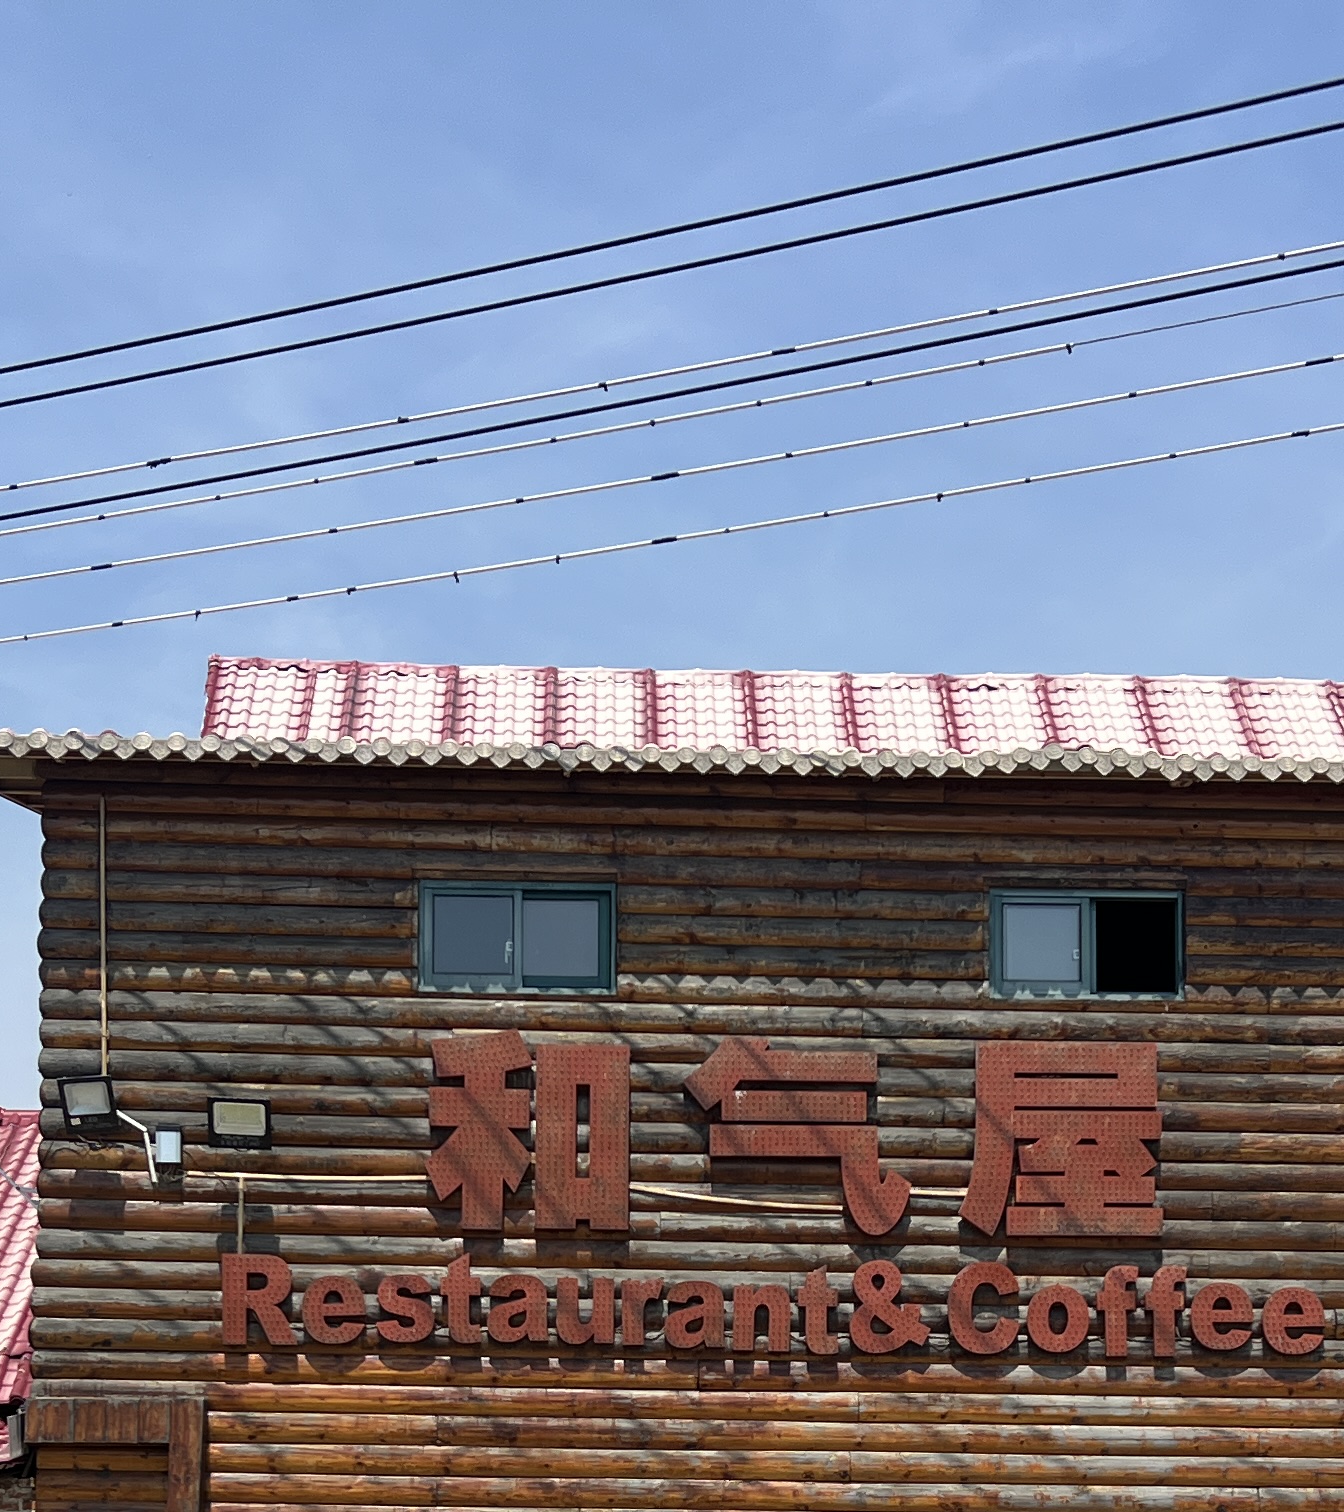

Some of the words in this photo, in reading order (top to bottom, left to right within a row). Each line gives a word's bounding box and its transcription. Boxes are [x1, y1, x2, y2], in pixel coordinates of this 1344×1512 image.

[424, 1029, 1164, 1237] 和气屋
[221, 1252, 1326, 1358] Restaurant&Coffee
